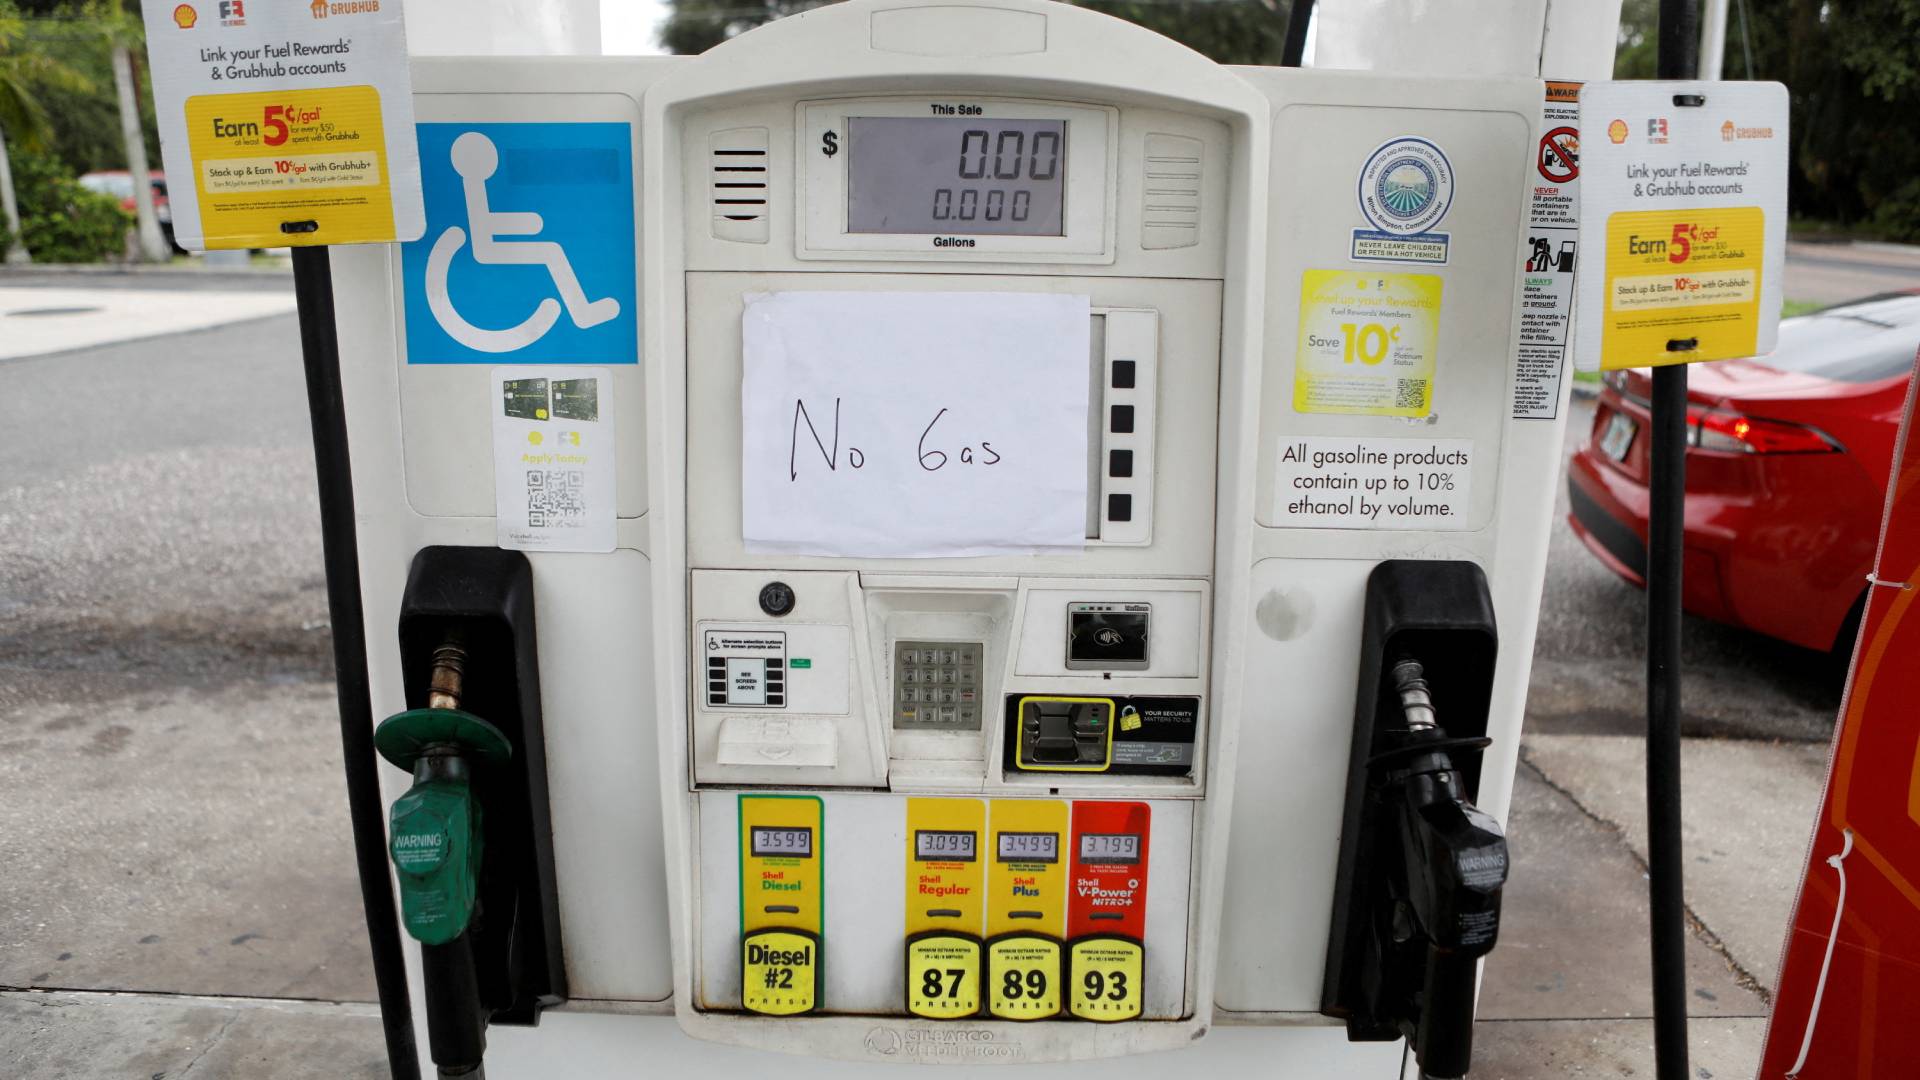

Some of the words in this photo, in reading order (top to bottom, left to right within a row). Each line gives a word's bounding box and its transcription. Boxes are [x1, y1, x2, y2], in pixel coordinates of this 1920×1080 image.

[331, 1, 379, 15] GRUBHUB
[201, 47, 227, 62] Link
[230, 49, 260, 64] your
[265, 42, 291, 58] Fuel
[212, 67, 222, 80] &
[226, 62, 286, 79] Grubhub
[289, 61, 346, 75] accounts
[931, 104, 955, 115] This
[959, 105, 982, 115] Sale
[213, 118, 259, 138] Earn
[1737, 128, 1773, 139] GRUBHUB
[325, 131, 359, 141] Grubhub
[822, 130, 838, 158] $
[959, 130, 1060, 180] 0.00
[210, 168, 231, 177] Stack
[234, 169, 244, 178] up
[247, 167, 252, 175] &
[255, 166, 273, 175] Earn
[309, 163, 327, 172] with
[1398, 146, 1424, 155] APPROVED
[1424, 151, 1434, 160] FOR
[1433, 158, 1447, 184] ACCURACY
[1627, 164, 1649, 178] Link
[1653, 167, 1678, 182] your
[1681, 162, 1701, 177] Fuel
[1634, 184, 1643, 197] &
[1647, 181, 1695, 196] Grubhub
[1699, 182, 1743, 195] accounts
[932, 189, 1031, 221] 0.000
[1405, 201, 1442, 230] Commissioner
[933, 237, 975, 248] Gallons
[1629, 235, 1666, 255] Earn
[1618, 285, 1636, 295] Stack
[1639, 286, 1648, 295] up
[1657, 284, 1672, 292] Earn
[1702, 280, 1716, 288] with
[1331, 307, 1345, 315] Fuel
[1380, 310, 1411, 318] Members
[1308, 335, 1340, 347] Save
[1393, 352, 1422, 360] Platinum
[791, 397, 864, 482] No
[522, 453, 553, 464] Apply
[557, 453, 587, 464] Today
[1282, 443, 1306, 463] All
[1313, 444, 1388, 468] gasoline
[1394, 445, 1468, 469] products
[1294, 473, 1358, 490] contain
[1365, 478, 1386, 495] up
[1393, 476, 1409, 490] to
[1418, 473, 1454, 491] 10%
[1288, 495, 1353, 514] ethanol
[1360, 496, 1382, 520] by
[1388, 497, 1454, 516] volume.
[395, 833, 442, 848] WARNING
[762, 832, 808, 848] 3.599
[925, 835, 971, 850] 3.099
[1006, 836, 1052, 852] 3.499
[1088, 837, 1134, 852] 3.799
[1459, 854, 1504, 870] WARNING
[762, 871, 784, 879] Shell
[920, 875, 941, 883] Shell
[1014, 877, 1035, 885] Shell
[1077, 878, 1099, 887] Shell
[762, 880, 801, 891] Diesel
[919, 884, 970, 897] Regular
[1013, 886, 1040, 896] Plus
[1077, 887, 1133, 897] V-Power
[749, 944, 810, 966] Diesel
[765, 968, 793, 989] #2
[922, 968, 966, 998] 87
[1003, 969, 1047, 1000] 89
[1084, 970, 1128, 1001] 93
[905, 1030, 993, 1042] GILBARCO
